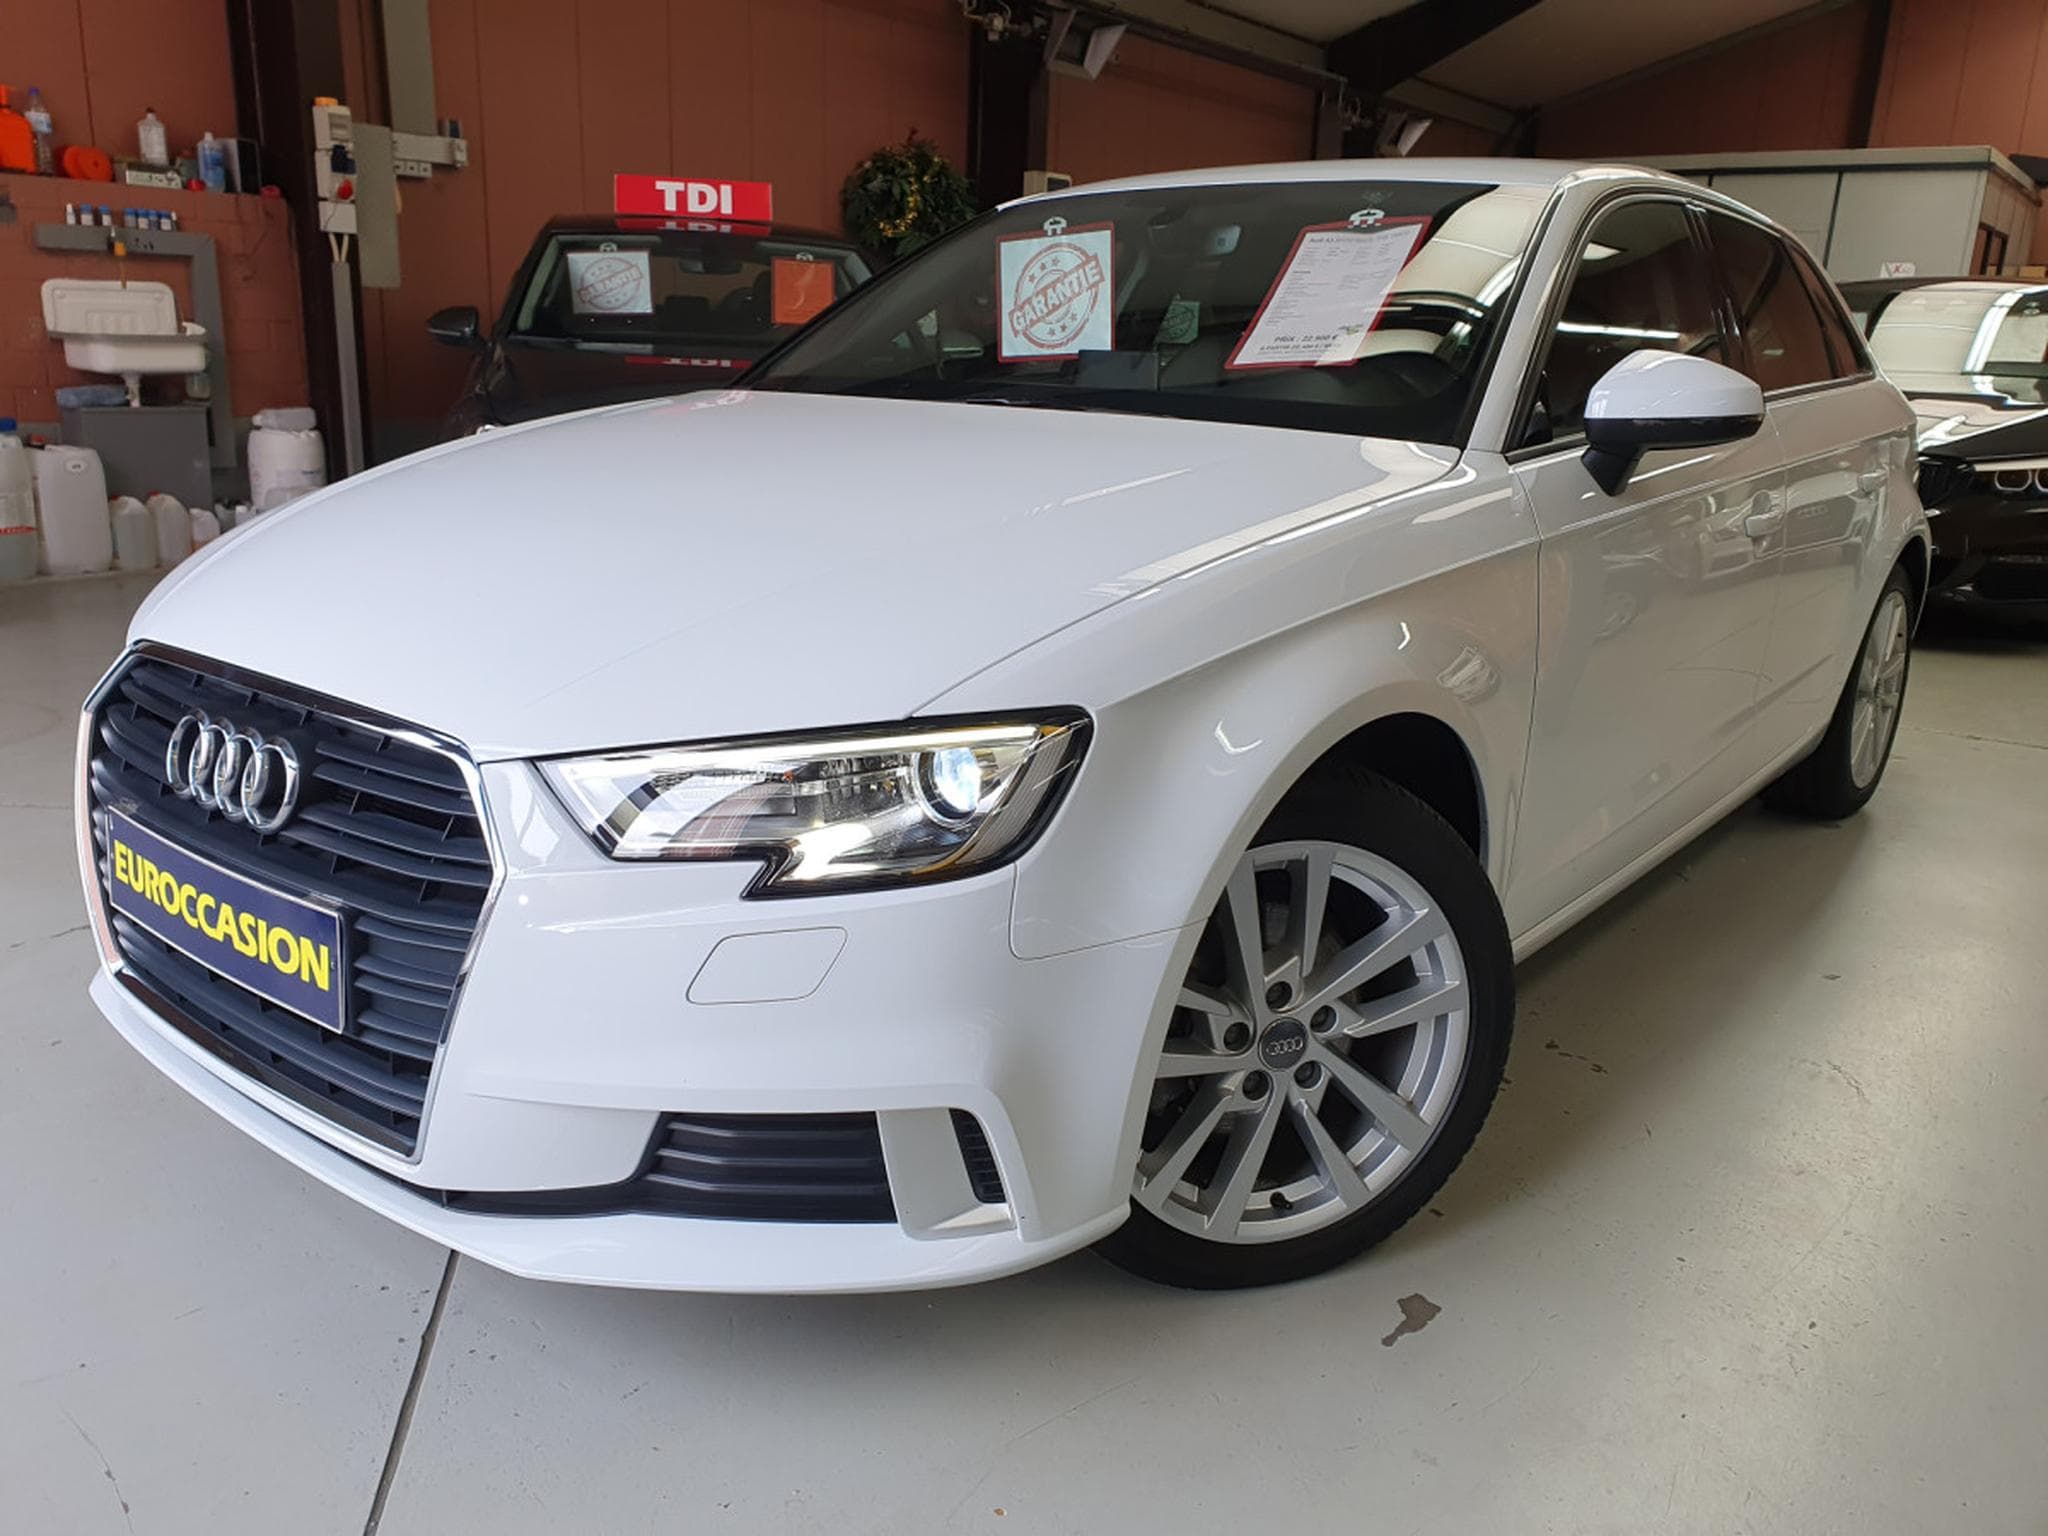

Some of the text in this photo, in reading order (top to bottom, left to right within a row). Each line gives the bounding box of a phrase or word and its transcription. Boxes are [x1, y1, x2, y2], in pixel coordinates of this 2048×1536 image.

[655, 180, 733, 215] TDI
[1010, 256, 1103, 333] GARANTIE
[114, 840, 329, 991] EUROCCASION
